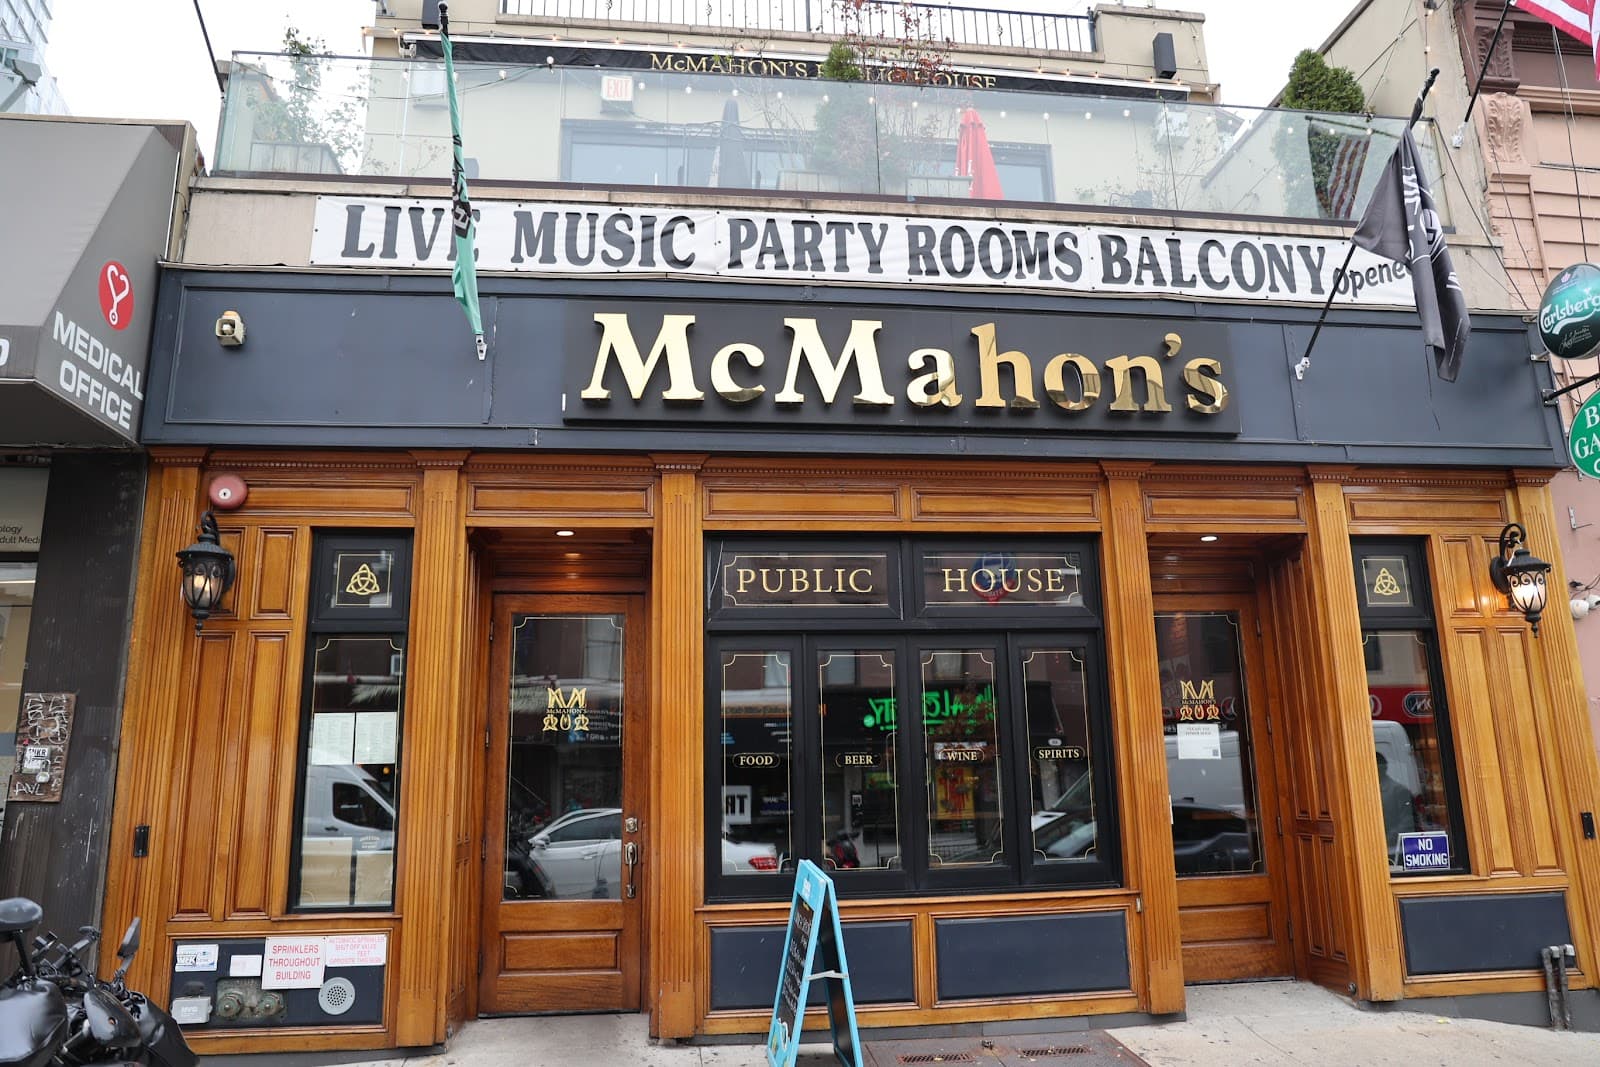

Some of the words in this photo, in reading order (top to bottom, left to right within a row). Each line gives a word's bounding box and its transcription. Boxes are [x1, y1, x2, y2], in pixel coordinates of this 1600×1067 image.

[650, 52, 807, 78] McMAHON'S
[606, 78, 631, 98] EXIT
[510, 210, 696, 270] MUSIC
[727, 217, 889, 274] PARTY
[905, 224, 1083, 283] ROOMS
[1097, 234, 1326, 296] BALCONY
[53, 310, 144, 401] MEDICAL
[580, 312, 1229, 415] McMahon's
[60, 359, 133, 430] OFFICE
[736, 568, 874, 594] PUBLIC
[942, 568, 1066, 594] HOUSE
[844, 754, 873, 765] BEER
[947, 751, 978, 761] WINE
[1038, 748, 1080, 759] SPIRITS
[739, 755, 774, 766] FOOD
[1417, 838, 1433, 851] NO
[1405, 853, 1448, 867] SMOKING
[272, 944, 319, 954] SPRINKLERS
[268, 957, 321, 967] THROUGHOUT
[275, 970, 311, 981] BUILDING
